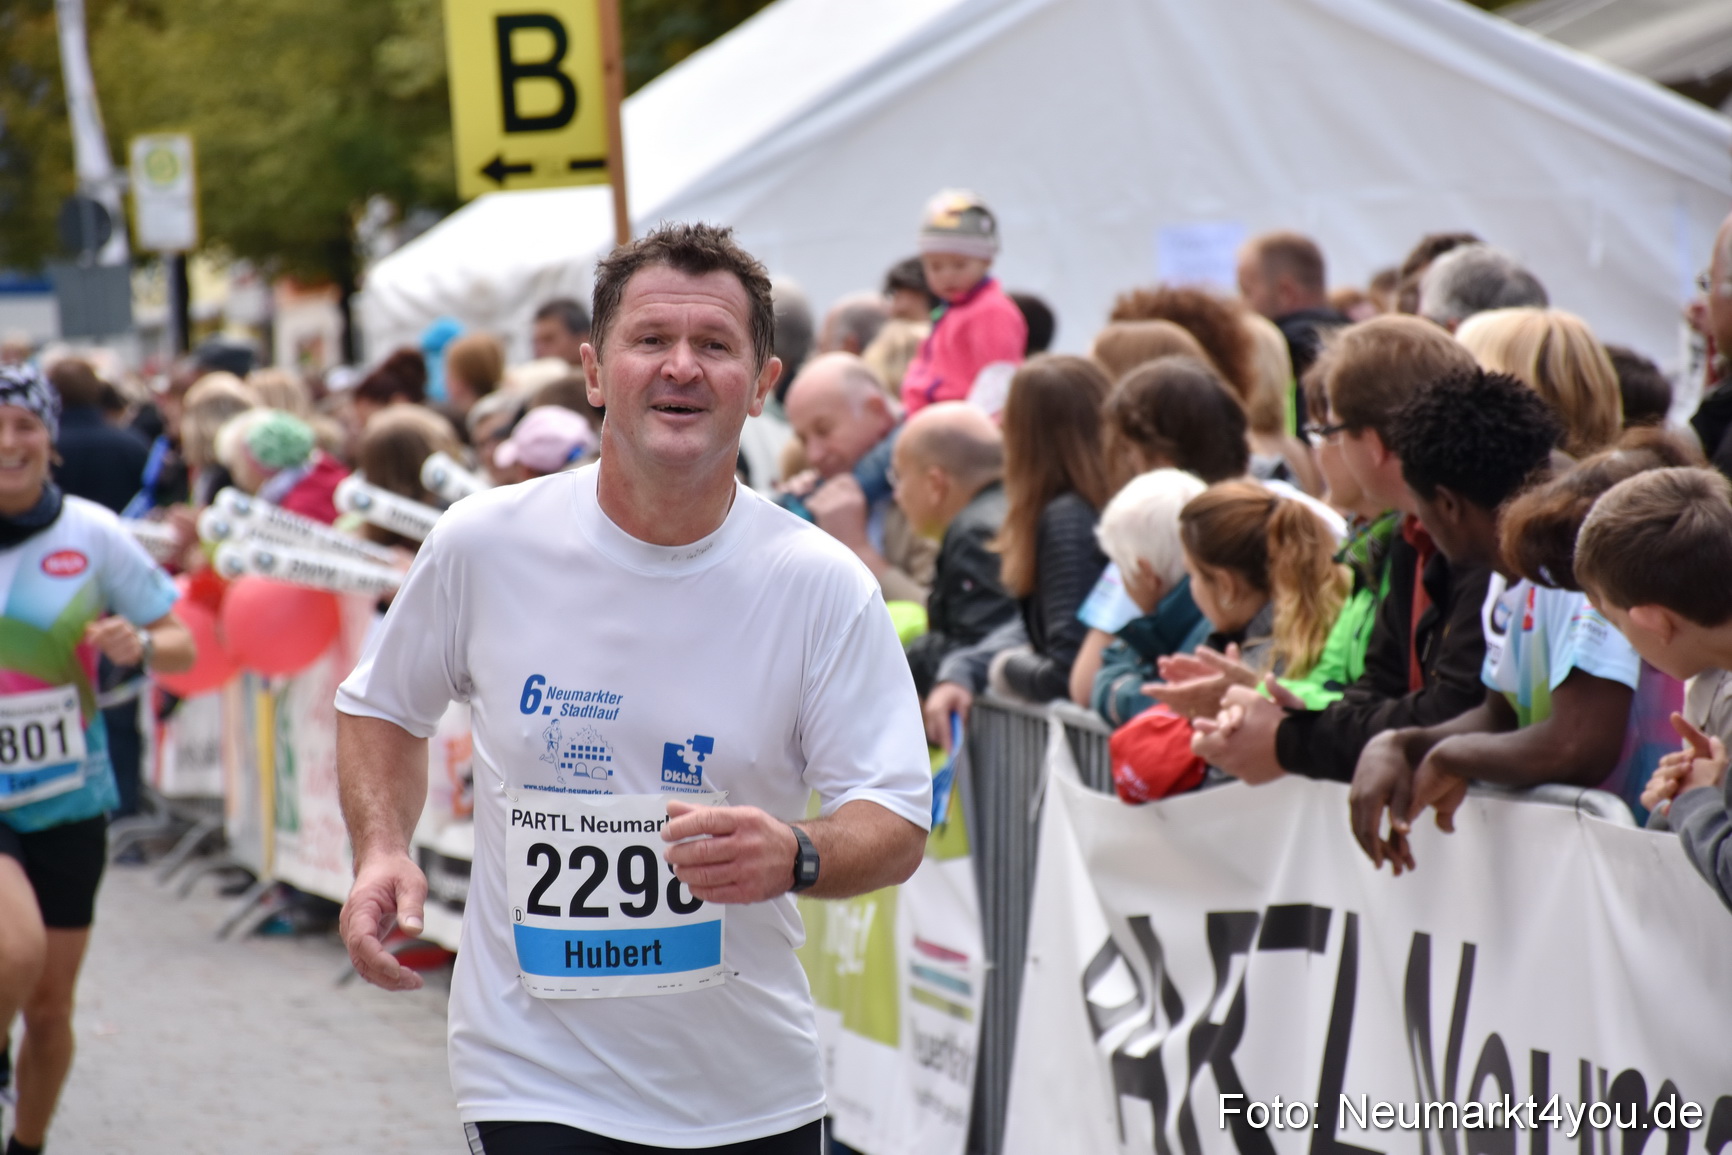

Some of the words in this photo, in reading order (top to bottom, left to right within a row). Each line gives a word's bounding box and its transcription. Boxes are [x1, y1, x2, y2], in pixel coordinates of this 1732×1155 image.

[495, 13, 577, 133] B
[519, 673, 553, 716] 6.
[546, 686, 623, 705] Neumarkter
[560, 702, 620, 721] Stadtlauf
[663, 769, 700, 785] DKMS
[511, 808, 575, 832] PARTL
[580, 814, 670, 834] Neumar
[564, 939, 663, 969] Hubert
